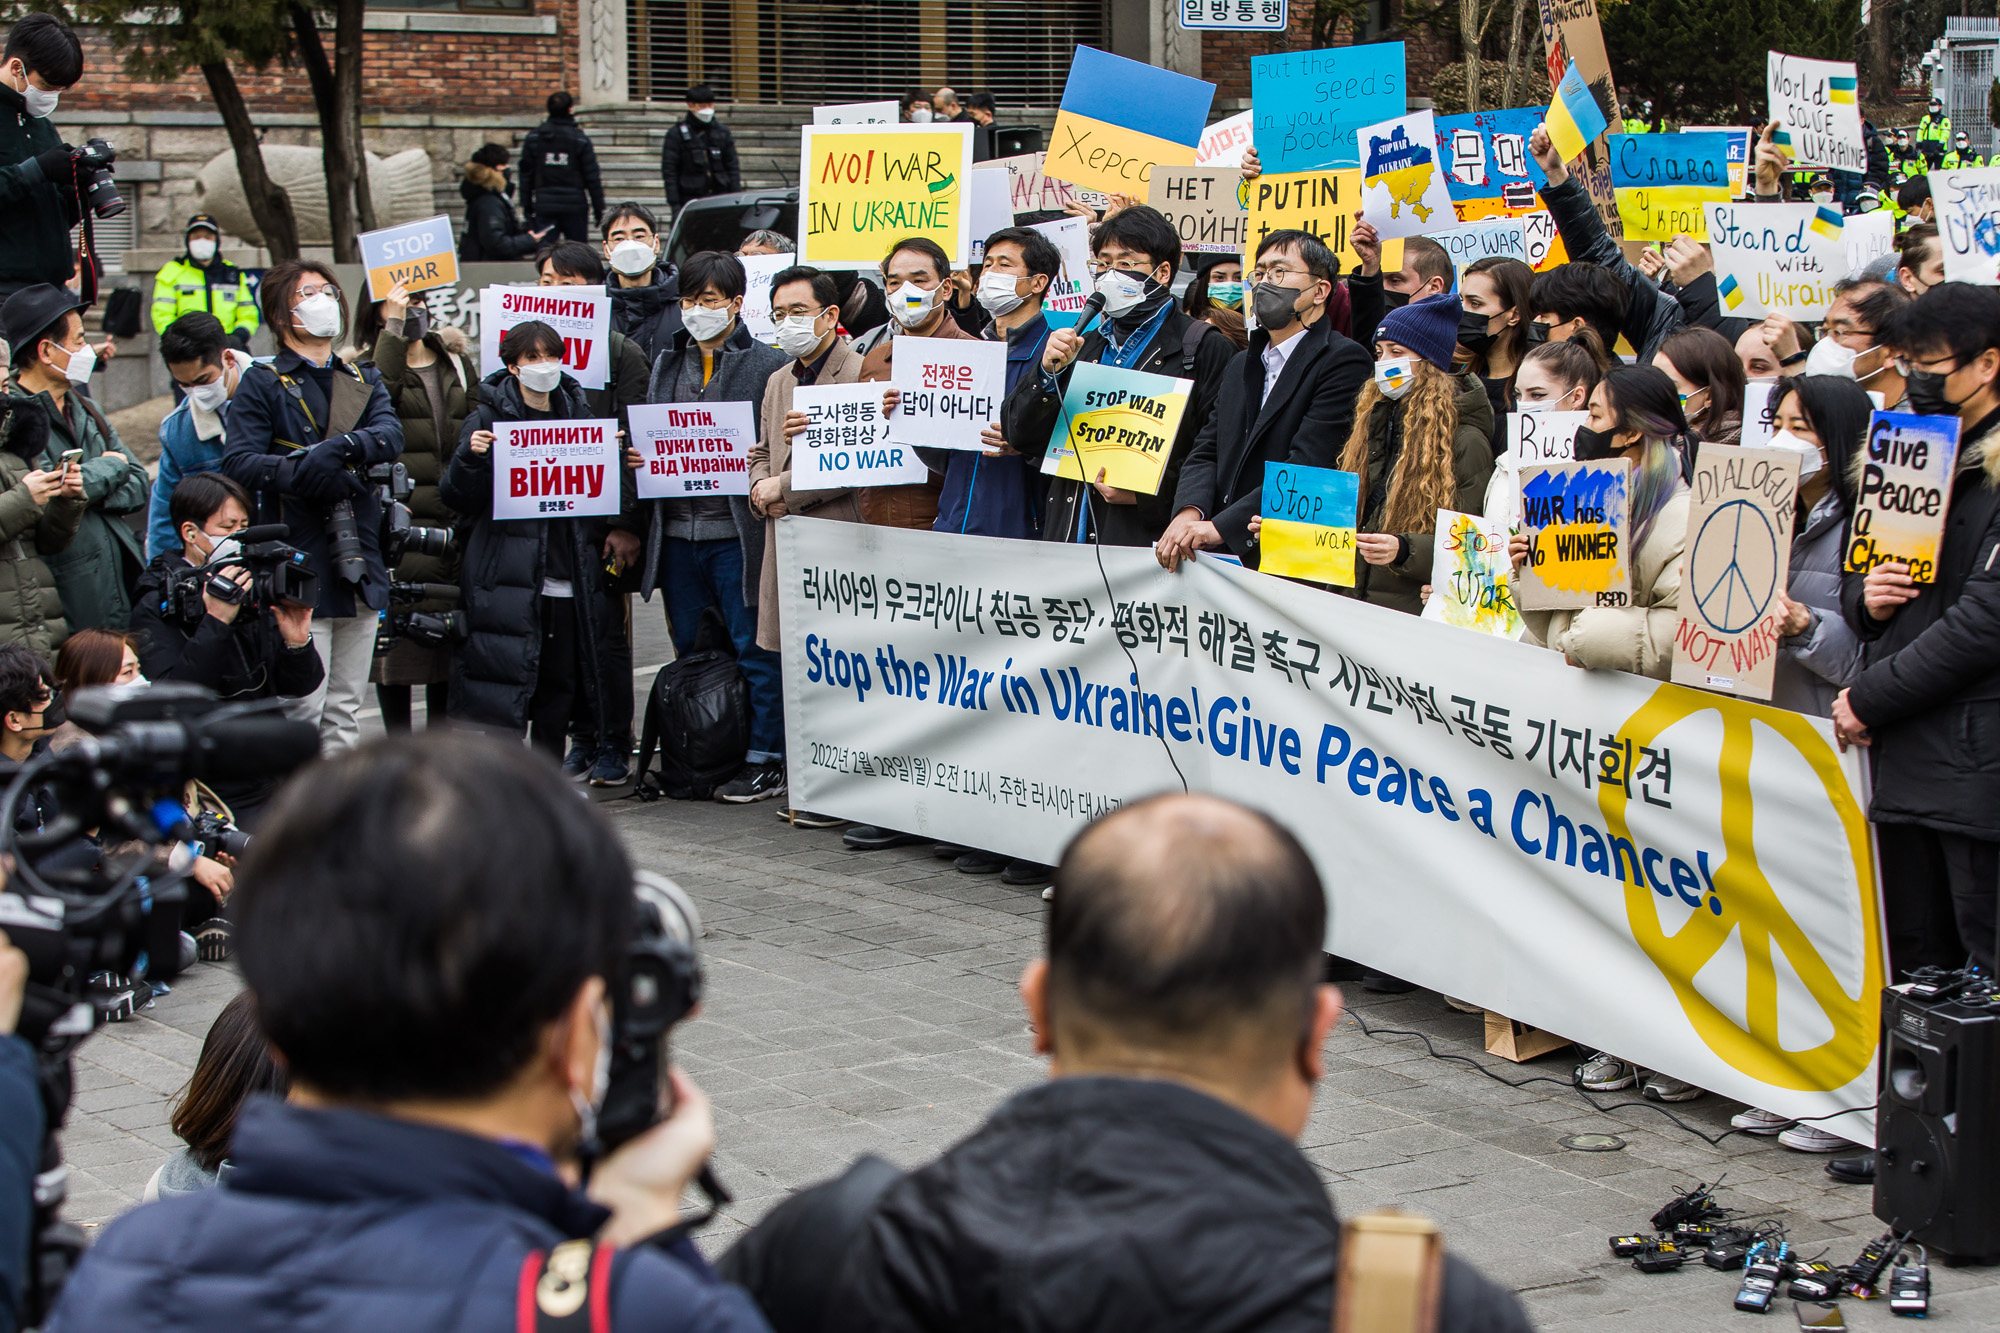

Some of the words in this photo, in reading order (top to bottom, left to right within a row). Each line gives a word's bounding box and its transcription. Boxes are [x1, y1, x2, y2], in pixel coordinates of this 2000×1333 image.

[1186, 0, 1280, 22] 일방통행
[1300, 52, 1335, 76] the
[1314, 68, 1396, 103] seeds
[1258, 113, 1274, 131] in
[1286, 108, 1341, 136] your
[1059, 125, 1157, 182] Херсо
[1282, 122, 1369, 162] pocke
[822, 150, 875, 185] NO!
[884, 151, 948, 183] WAR
[1621, 138, 1718, 183] Слава
[1167, 177, 1215, 200] НЕТ
[1257, 176, 1338, 211] PUTIN
[1947, 176, 2000, 204] STAN
[808, 201, 841, 235] IN
[853, 200, 949, 232] UKRAINE
[1636, 191, 1707, 233] Украї
[382, 232, 434, 260] STOP
[1482, 230, 1523, 255] WAR
[1713, 207, 1811, 253] Stand
[389, 262, 439, 285] WAR
[1053, 280, 1081, 296] WAR
[1758, 272, 1838, 307] Ukrain
[922, 363, 973, 390] 전쟁은
[806, 402, 877, 424] 군사행동
[902, 391, 934, 418] 답이
[940, 394, 993, 422] 아니다
[1085, 390, 1128, 407] STOP
[1129, 394, 1167, 419] WAR
[806, 425, 876, 448] 평화협상
[1076, 422, 1116, 443] STOP
[1116, 428, 1165, 453] PUTIN
[1520, 413, 1576, 460] Rus
[1868, 419, 1928, 470] Give
[819, 451, 850, 471] NO
[856, 449, 903, 469] WAR
[1698, 458, 1795, 535] DIALOGUE
[1858, 464, 1941, 517] Peace
[1523, 495, 1566, 527] WAR
[1574, 494, 1605, 524] has
[1556, 531, 1618, 562] WINNER
[1596, 591, 1628, 607] PSPD
[1675, 617, 1726, 671] NOT
[1730, 615, 1778, 673] WAR
[803, 566, 878, 620] 러시아의
[885, 578, 984, 634] 우크라이나
[989, 590, 1041, 638] 침공
[1198, 610, 1256, 673] 해결
[1262, 630, 1321, 691] 촉구
[1329, 653, 1454, 736] 시민사회
[1450, 694, 1514, 760] 공동
[1525, 719, 1672, 810] 기자회견
[806, 633, 872, 702] Stop
[875, 643, 930, 701] the
[934, 653, 995, 711] War
[1000, 657, 1040, 715] in
[1317, 723, 1460, 821] Peace
[1467, 788, 1497, 840] a
[1510, 788, 1722, 916] Chance!
[810, 742, 849, 774] 2022년
[852, 750, 877, 777] 2월
[934, 762, 959, 793] 오전
[1000, 775, 1027, 807] 주한
[1031, 781, 1074, 818] 러시아
